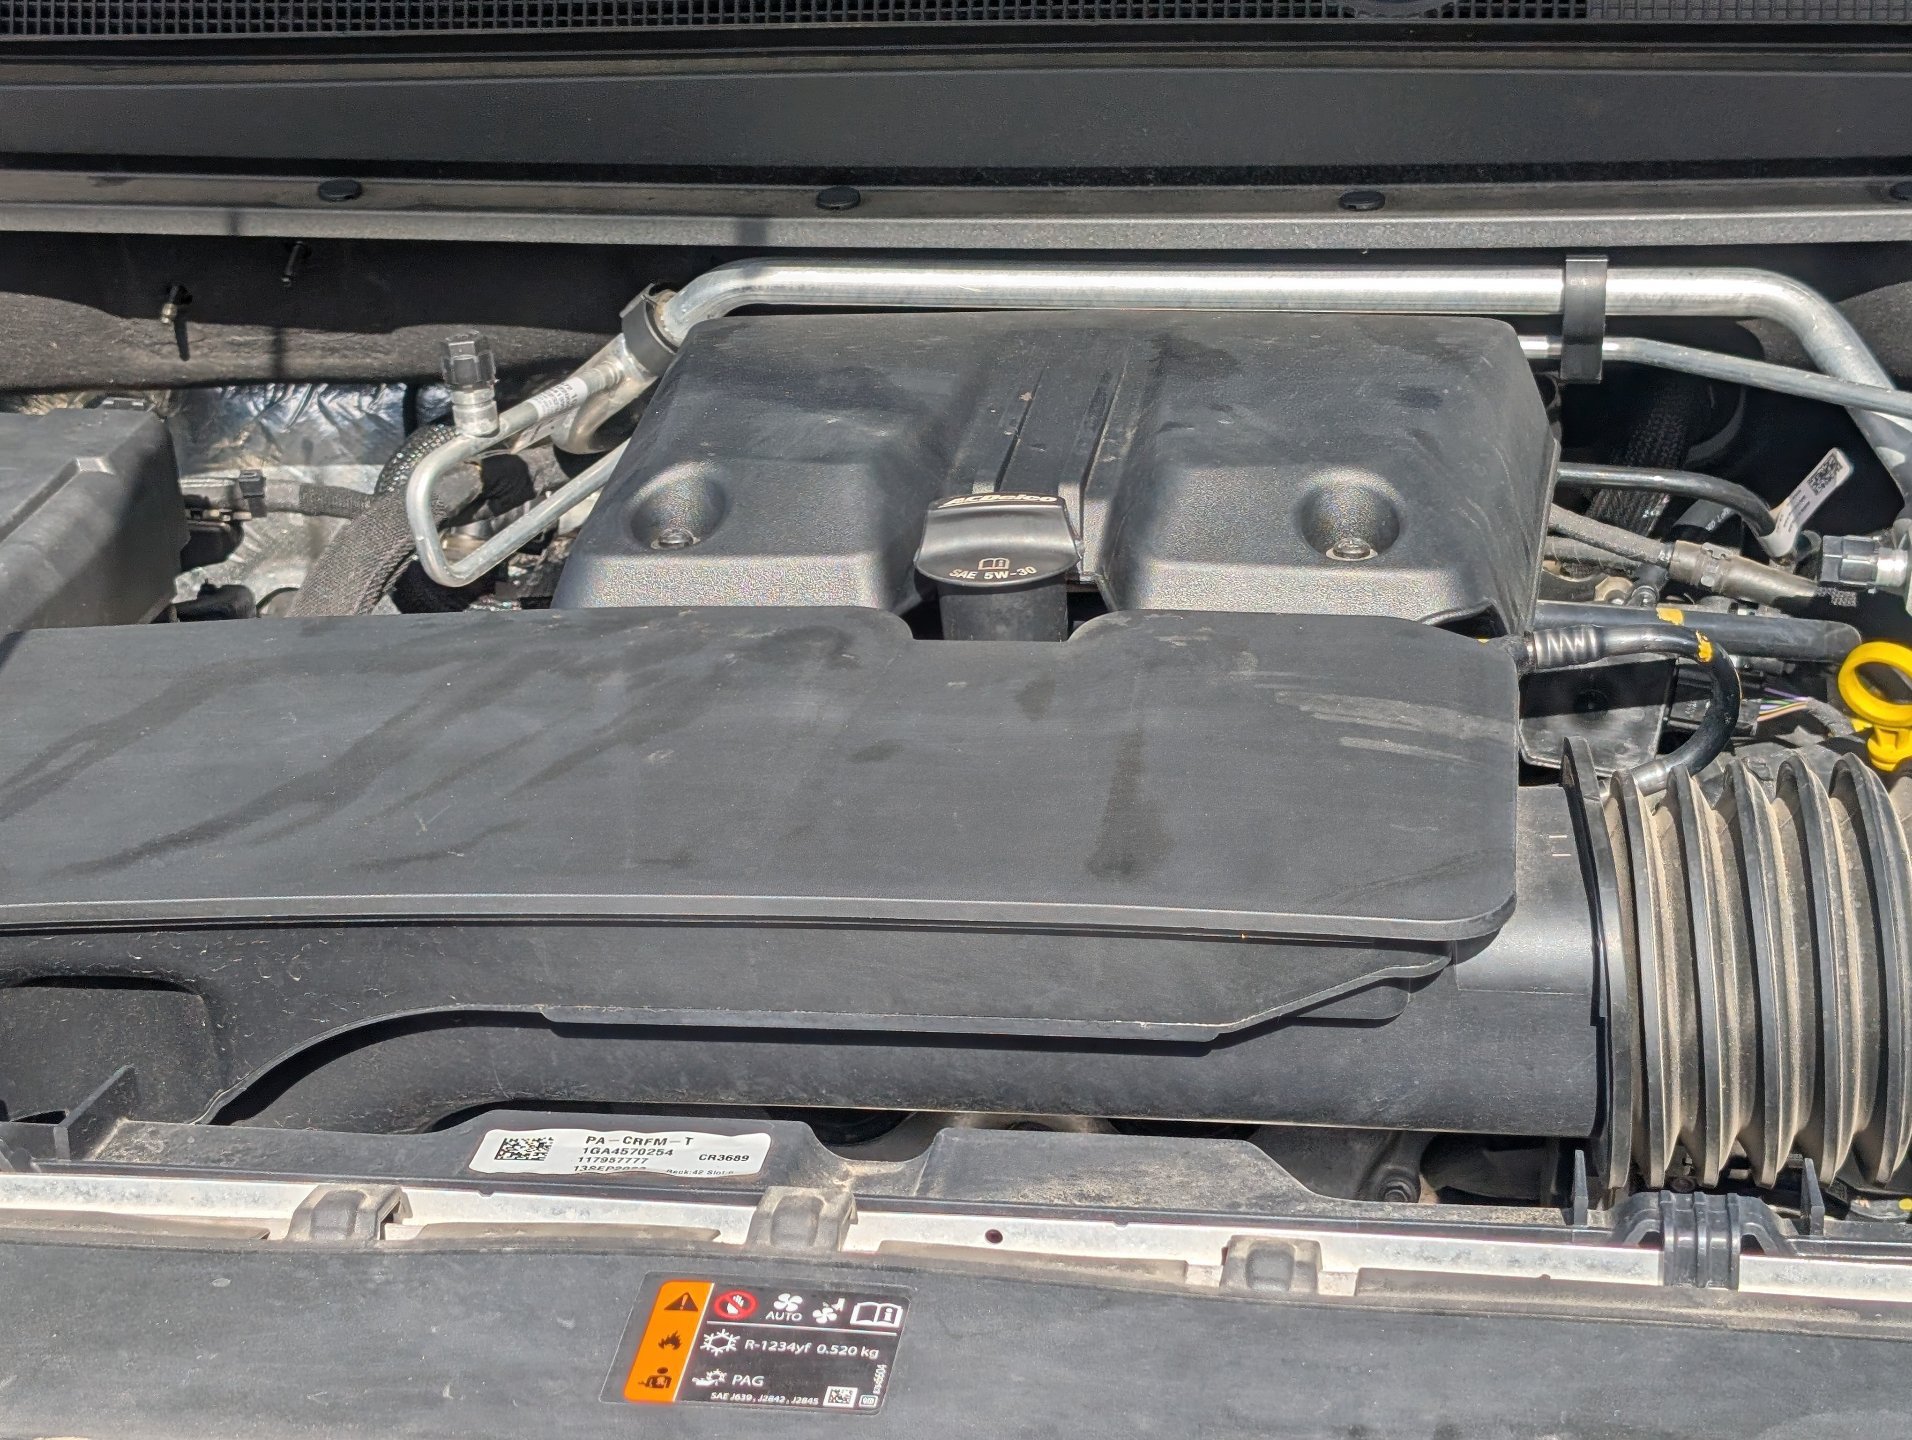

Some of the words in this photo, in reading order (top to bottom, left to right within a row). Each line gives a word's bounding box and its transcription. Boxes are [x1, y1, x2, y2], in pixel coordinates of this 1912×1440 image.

[938, 494, 1058, 509] ACDelco
[948, 568, 979, 580] SAE
[984, 566, 1037, 580] 5W-30
[583, 1147, 674, 1156] 1GA4570254
[698, 1154, 750, 1162] CR3689
[765, 1311, 803, 1321] AUTO
[744, 1339, 812, 1354] R-1234yf
[816, 1343, 858, 1356] 0.520
[861, 1346, 880, 1359] kg
[731, 1374, 765, 1387] PAG
[710, 1391, 730, 1400] SAE
